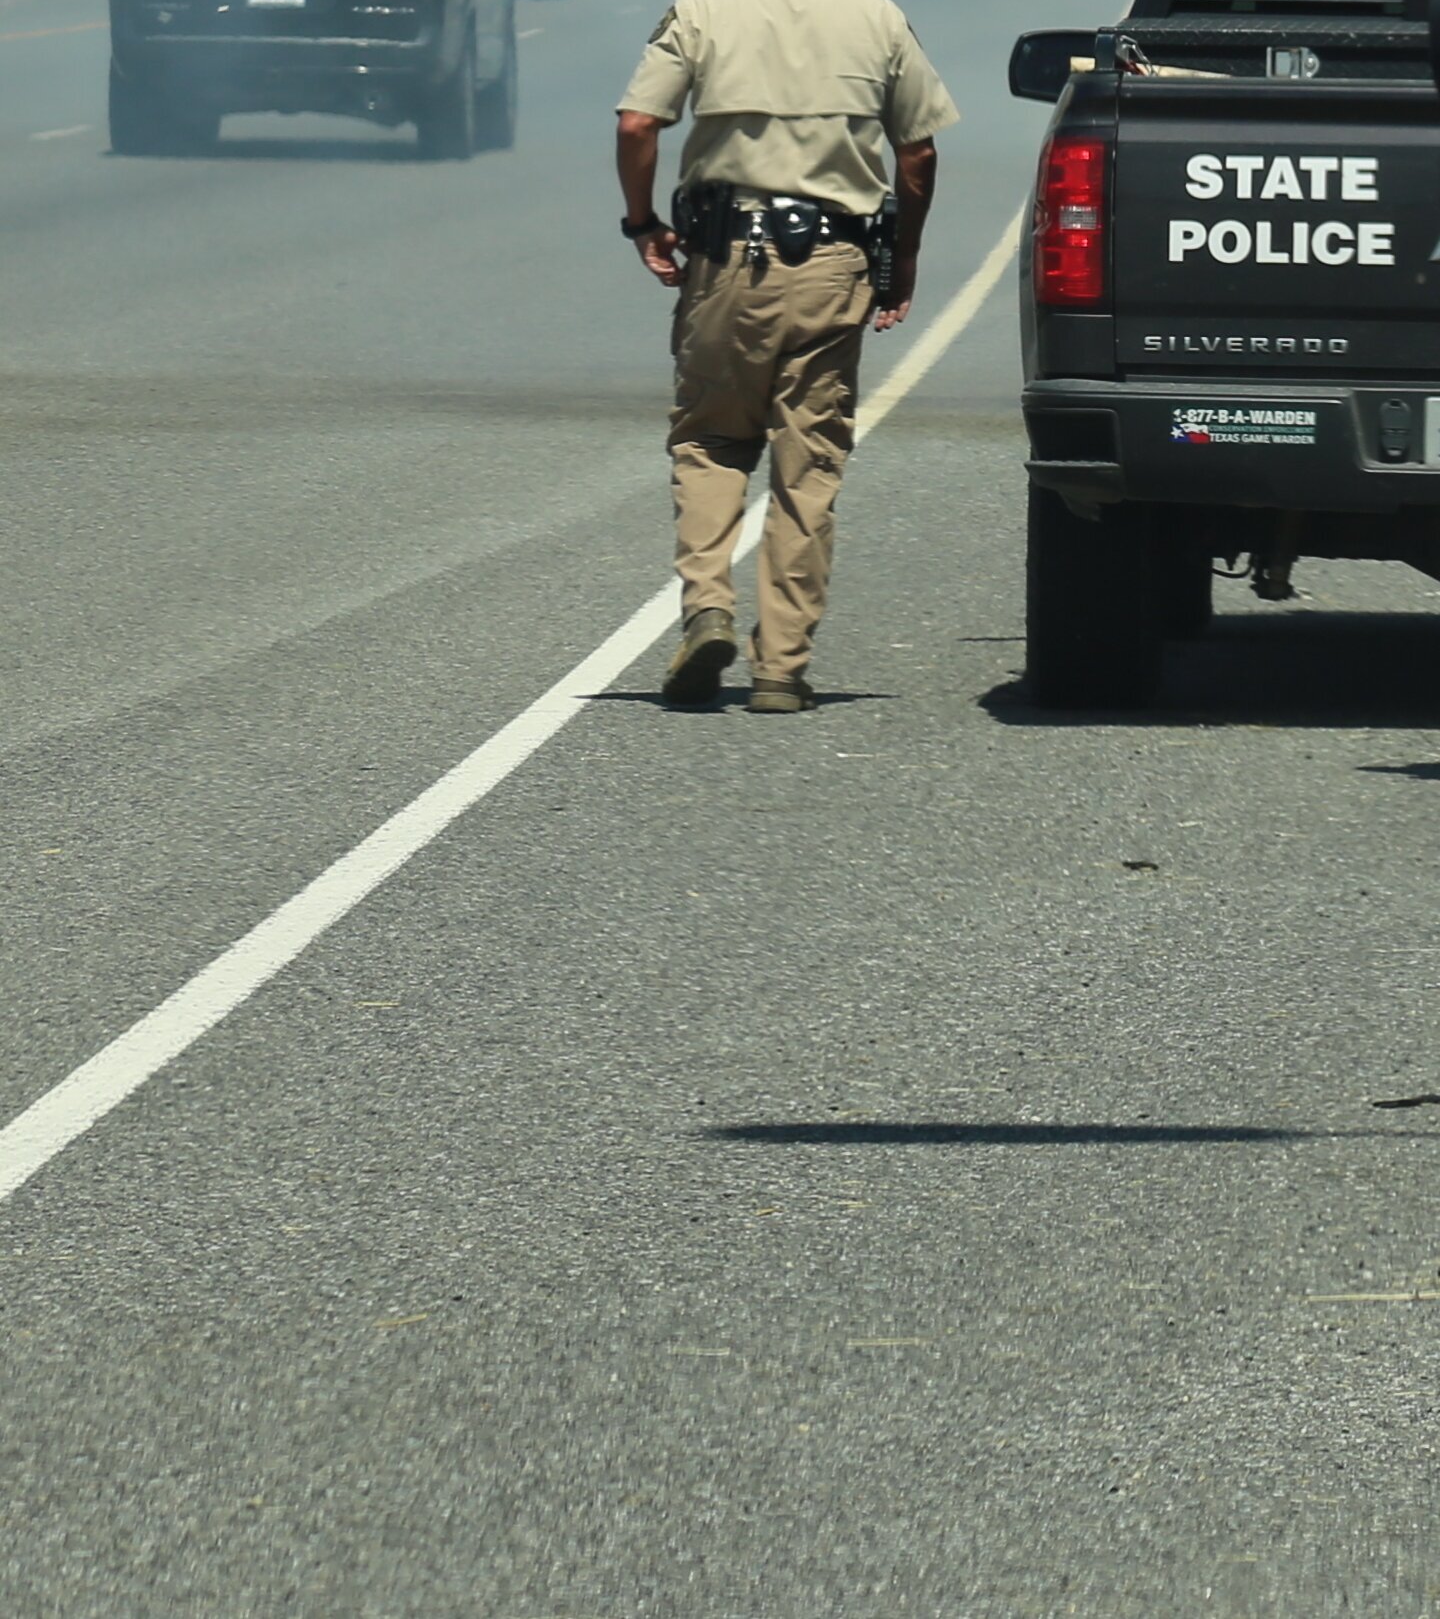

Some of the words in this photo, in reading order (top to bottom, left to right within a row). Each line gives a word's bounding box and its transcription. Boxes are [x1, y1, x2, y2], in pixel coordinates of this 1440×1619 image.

[1185, 153, 1378, 201] STATE
[1168, 219, 1395, 265] POLICE
[1144, 336, 1348, 353] SILVERADO
[1209, 433, 1240, 442] TEXAS
[1241, 433, 1271, 443] GAME
[1272, 434, 1315, 444] WARDEN
